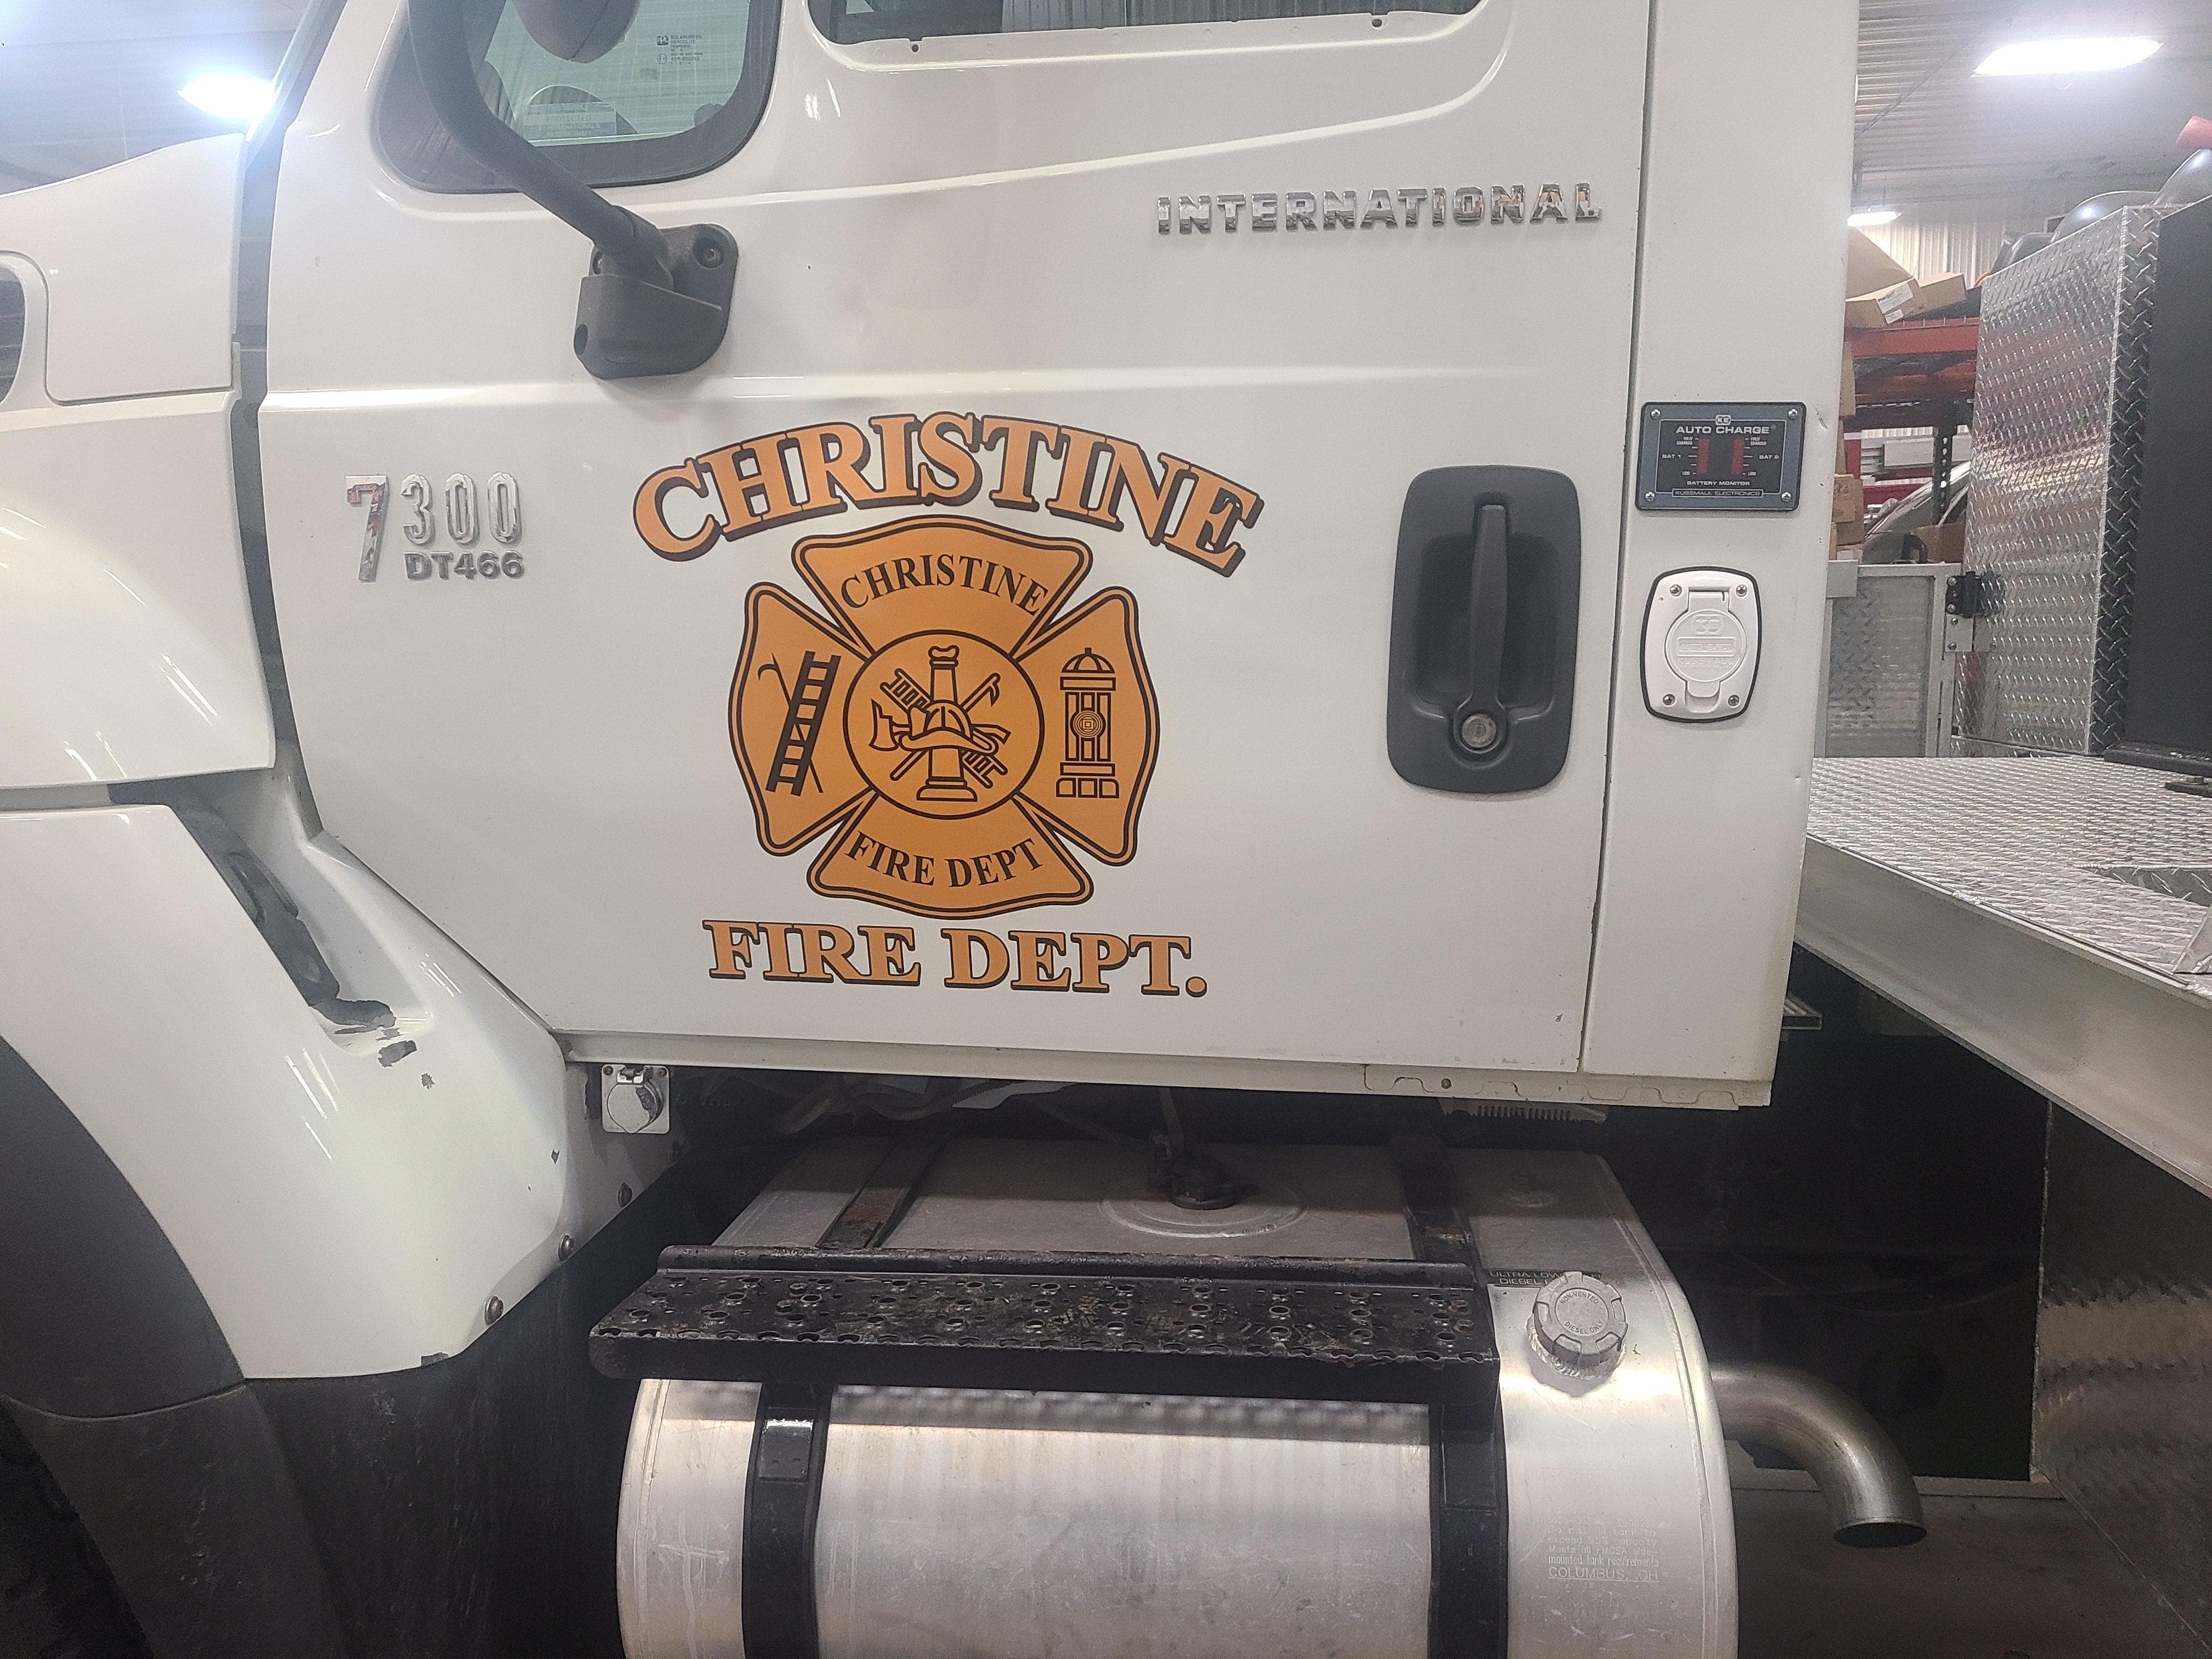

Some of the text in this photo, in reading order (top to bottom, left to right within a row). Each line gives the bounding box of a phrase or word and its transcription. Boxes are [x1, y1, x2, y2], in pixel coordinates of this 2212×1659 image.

[1156, 181, 1602, 235] INTERNATIONAL
[1675, 426, 1770, 435] AUTO CHARGE
[633, 410, 1265, 578] CHRISTINE
[345, 472, 522, 583] 7300
[404, 550, 525, 580] DT466
[840, 553, 1050, 617] CHRISTINE
[844, 831, 1043, 888] FIRE DEPT
[702, 919, 1208, 998] FIRE DEPT.
[1565, 1321, 1604, 1334] DIESEL ONLY
[1548, 1536, 1582, 1544] exceed
[1581, 1545, 1591, 1554] all
[1596, 1546, 1628, 1555] FMCSA
[1548, 1554, 1660, 1567] mounted tank requirements
[1548, 1567, 1629, 1581] COLUMBUS,
